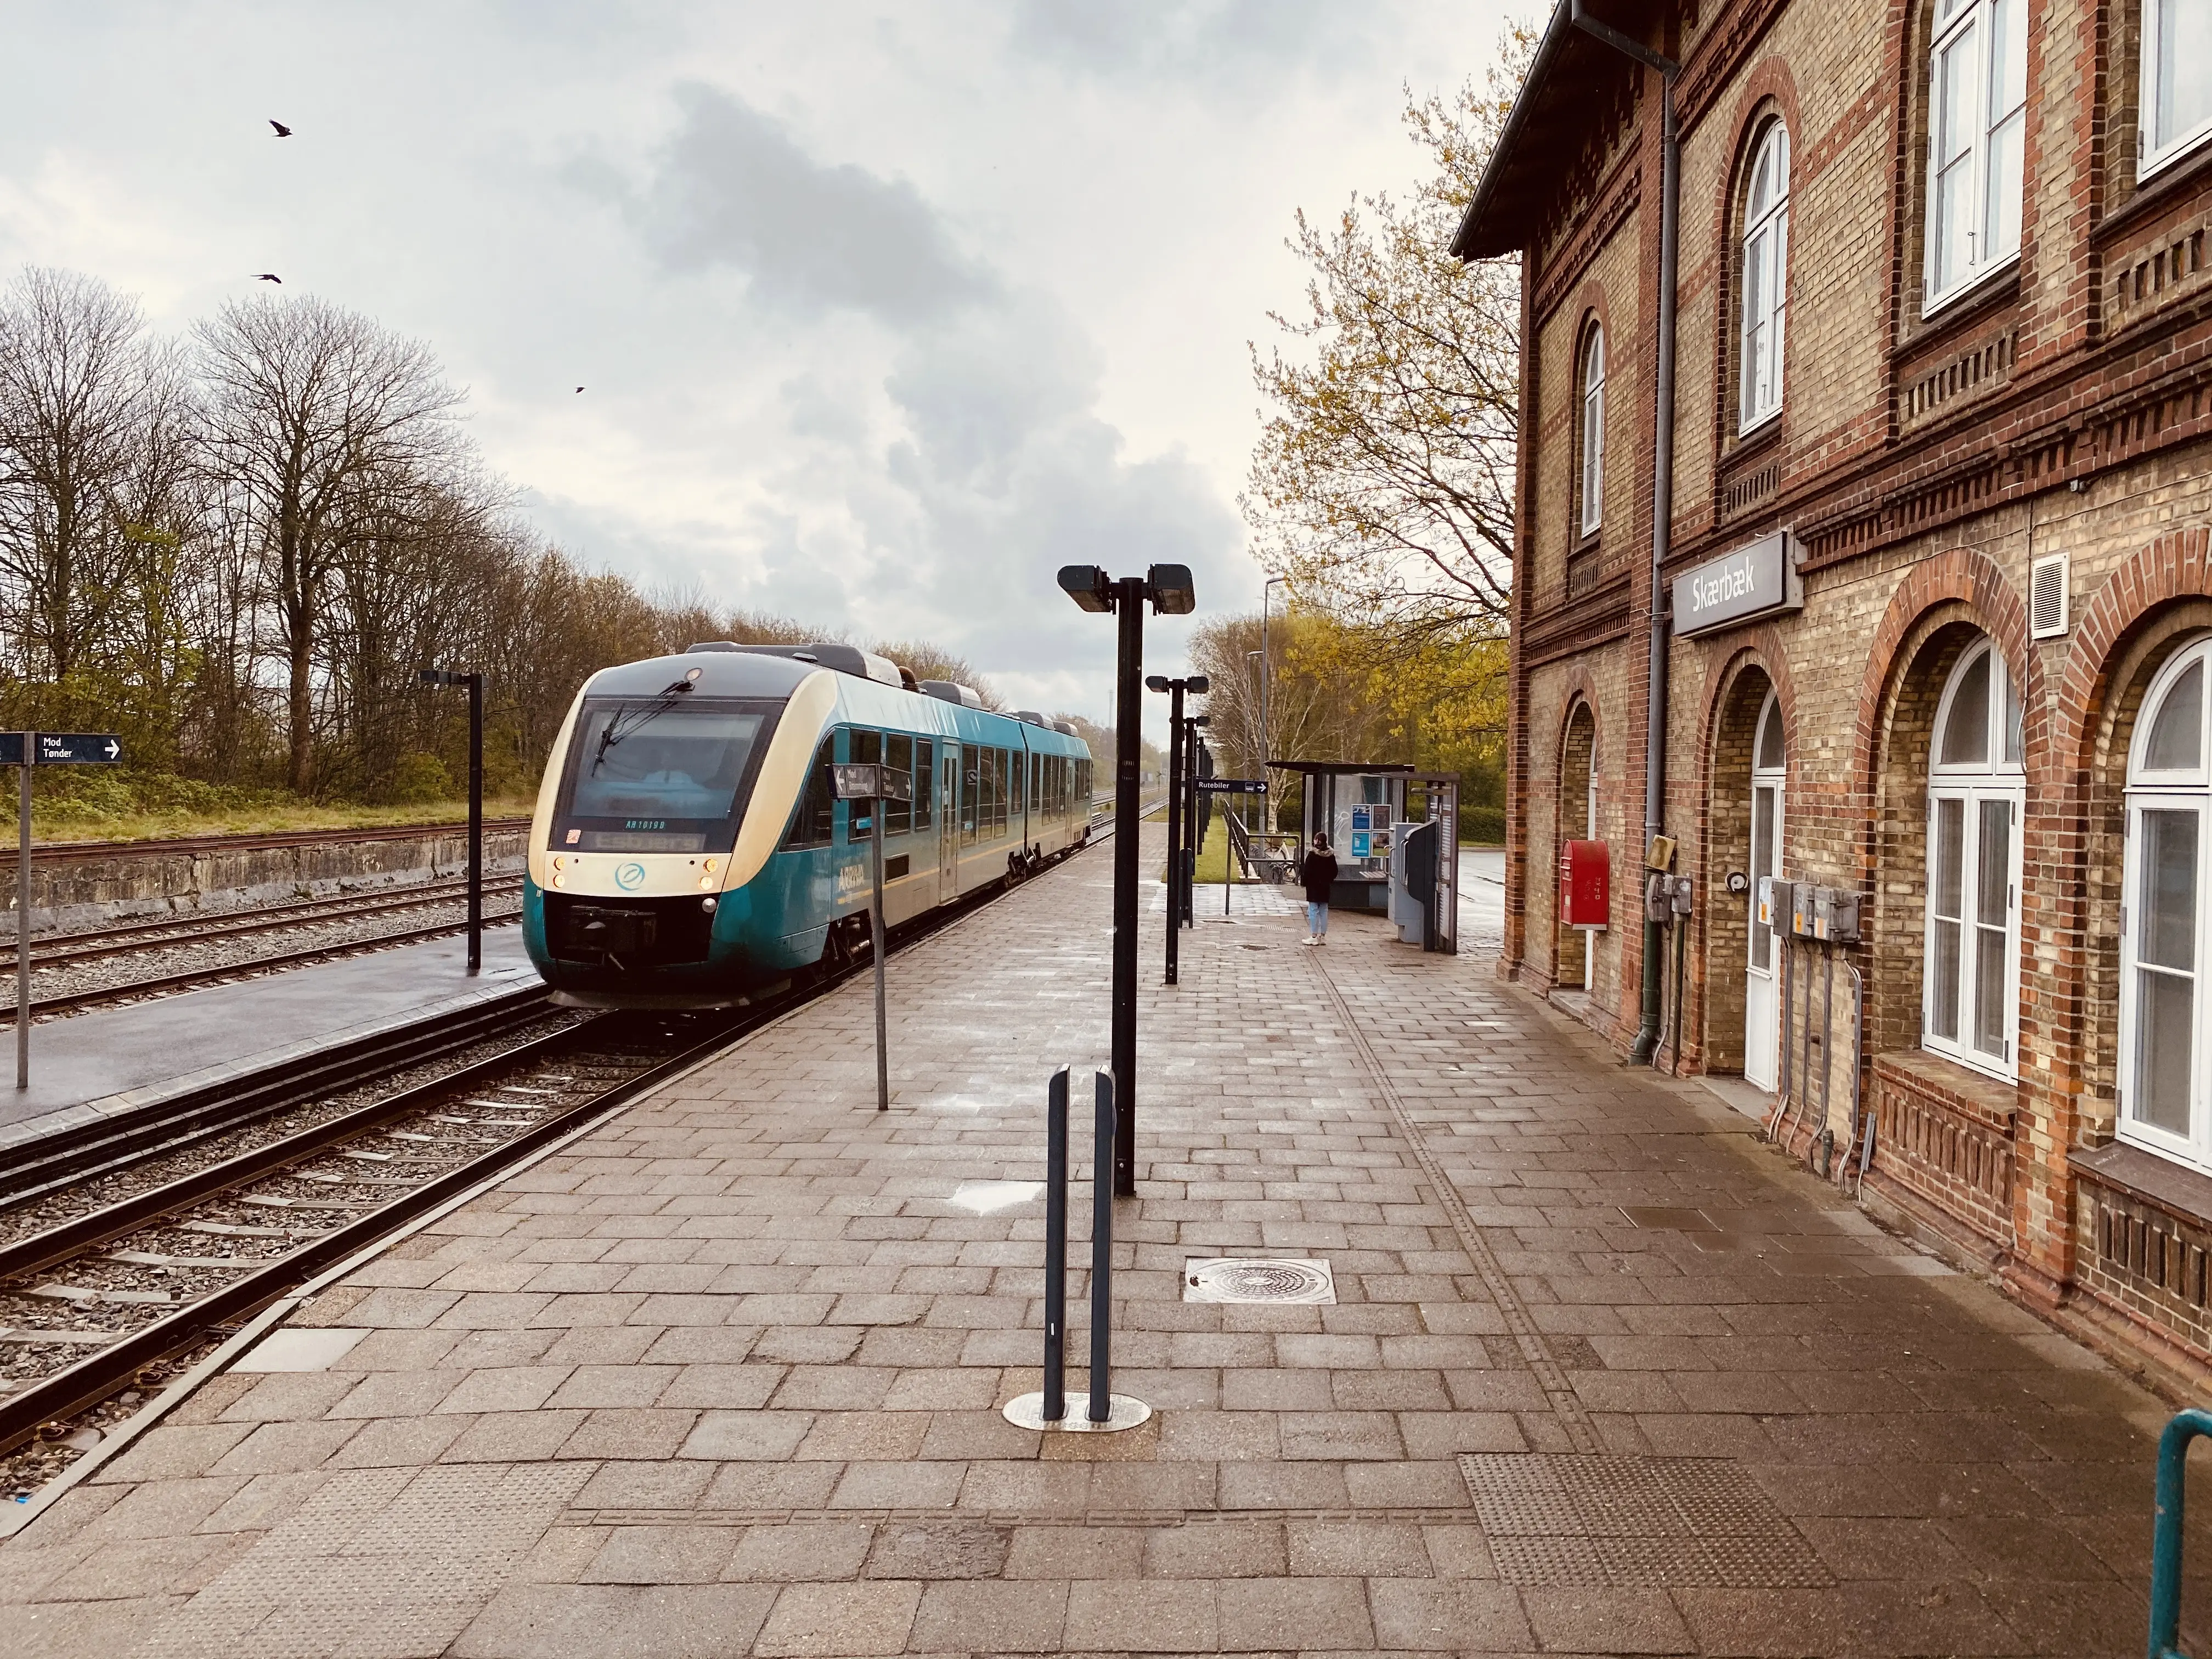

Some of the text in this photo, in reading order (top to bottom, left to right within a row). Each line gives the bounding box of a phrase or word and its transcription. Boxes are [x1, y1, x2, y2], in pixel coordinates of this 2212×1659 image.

[1692, 555, 1755, 612] Skærbæk
[43, 737, 61, 747] Mod
[43, 748, 72, 758] Tønder
